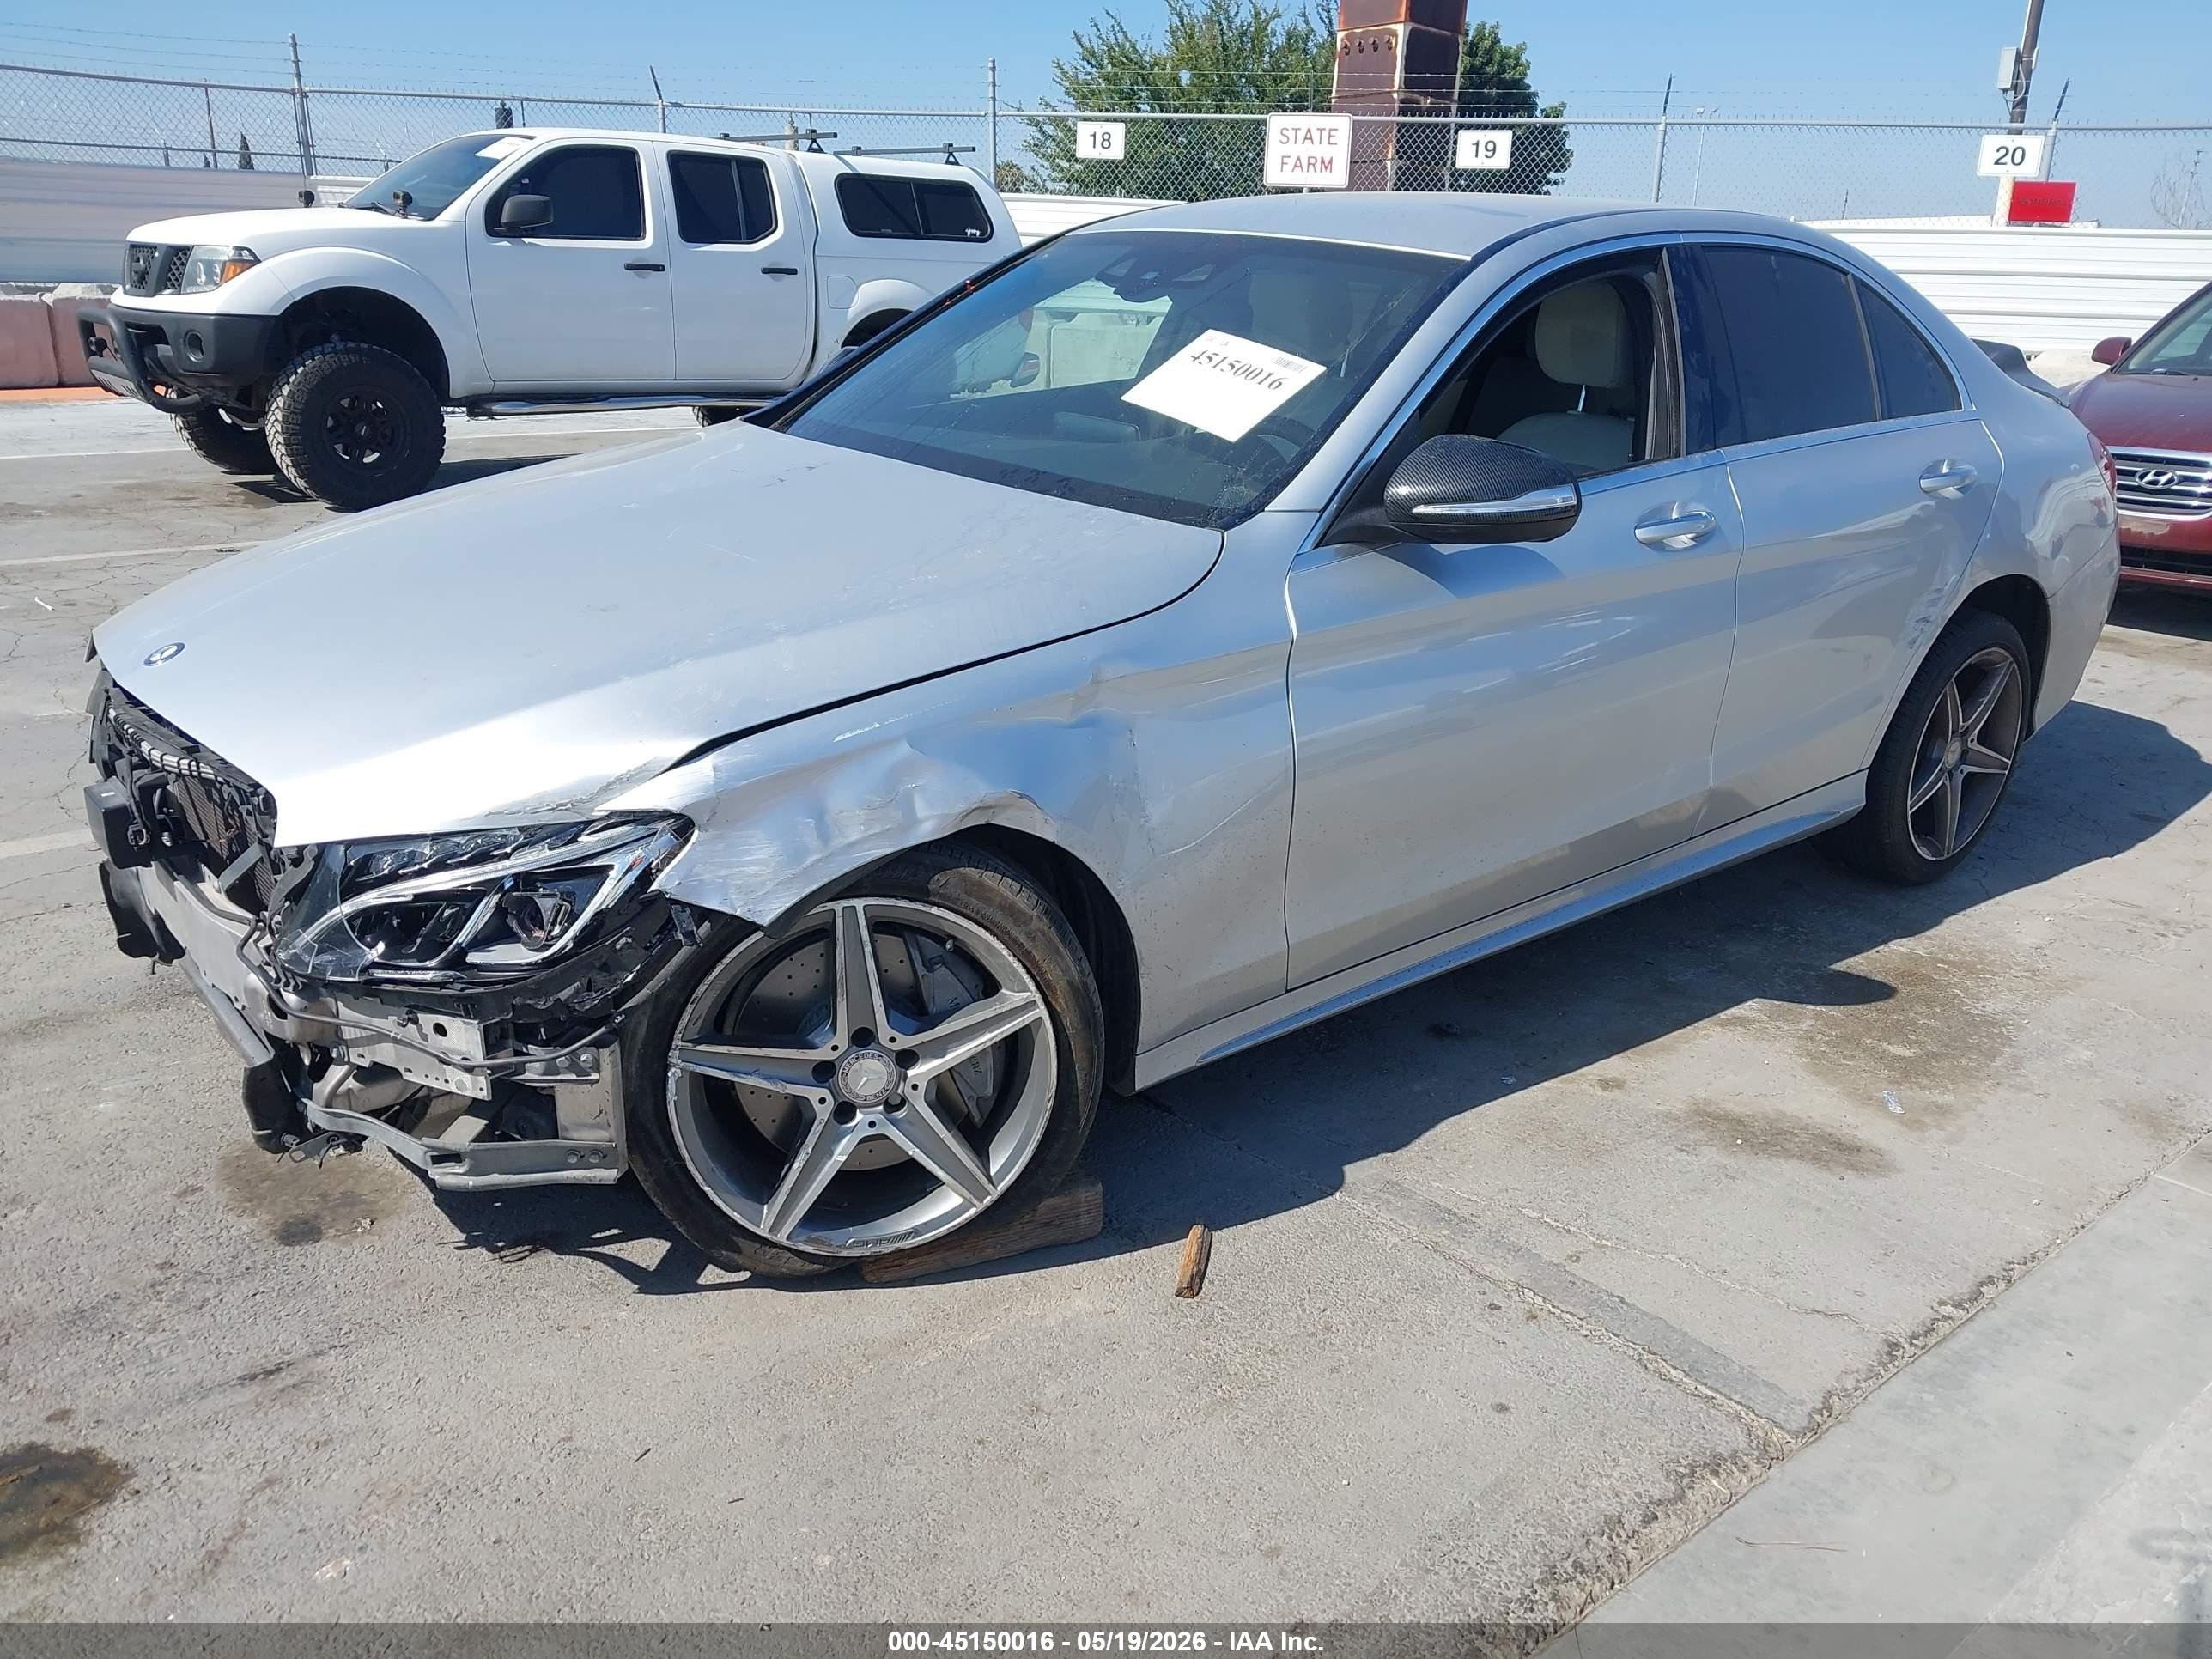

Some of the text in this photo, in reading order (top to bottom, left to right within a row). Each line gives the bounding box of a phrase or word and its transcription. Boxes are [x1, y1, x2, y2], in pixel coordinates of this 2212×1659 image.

[1090, 131, 1112, 150] 18
[1279, 128, 1338, 145] STATE
[1472, 140, 1497, 159] 19
[1993, 146, 2026, 167] 20
[1280, 155, 1334, 173] FARM
[1190, 349, 1289, 391] 45150016
[842, 1052, 879, 1073] MERCEDES
[866, 1088, 889, 1101] BENZ
